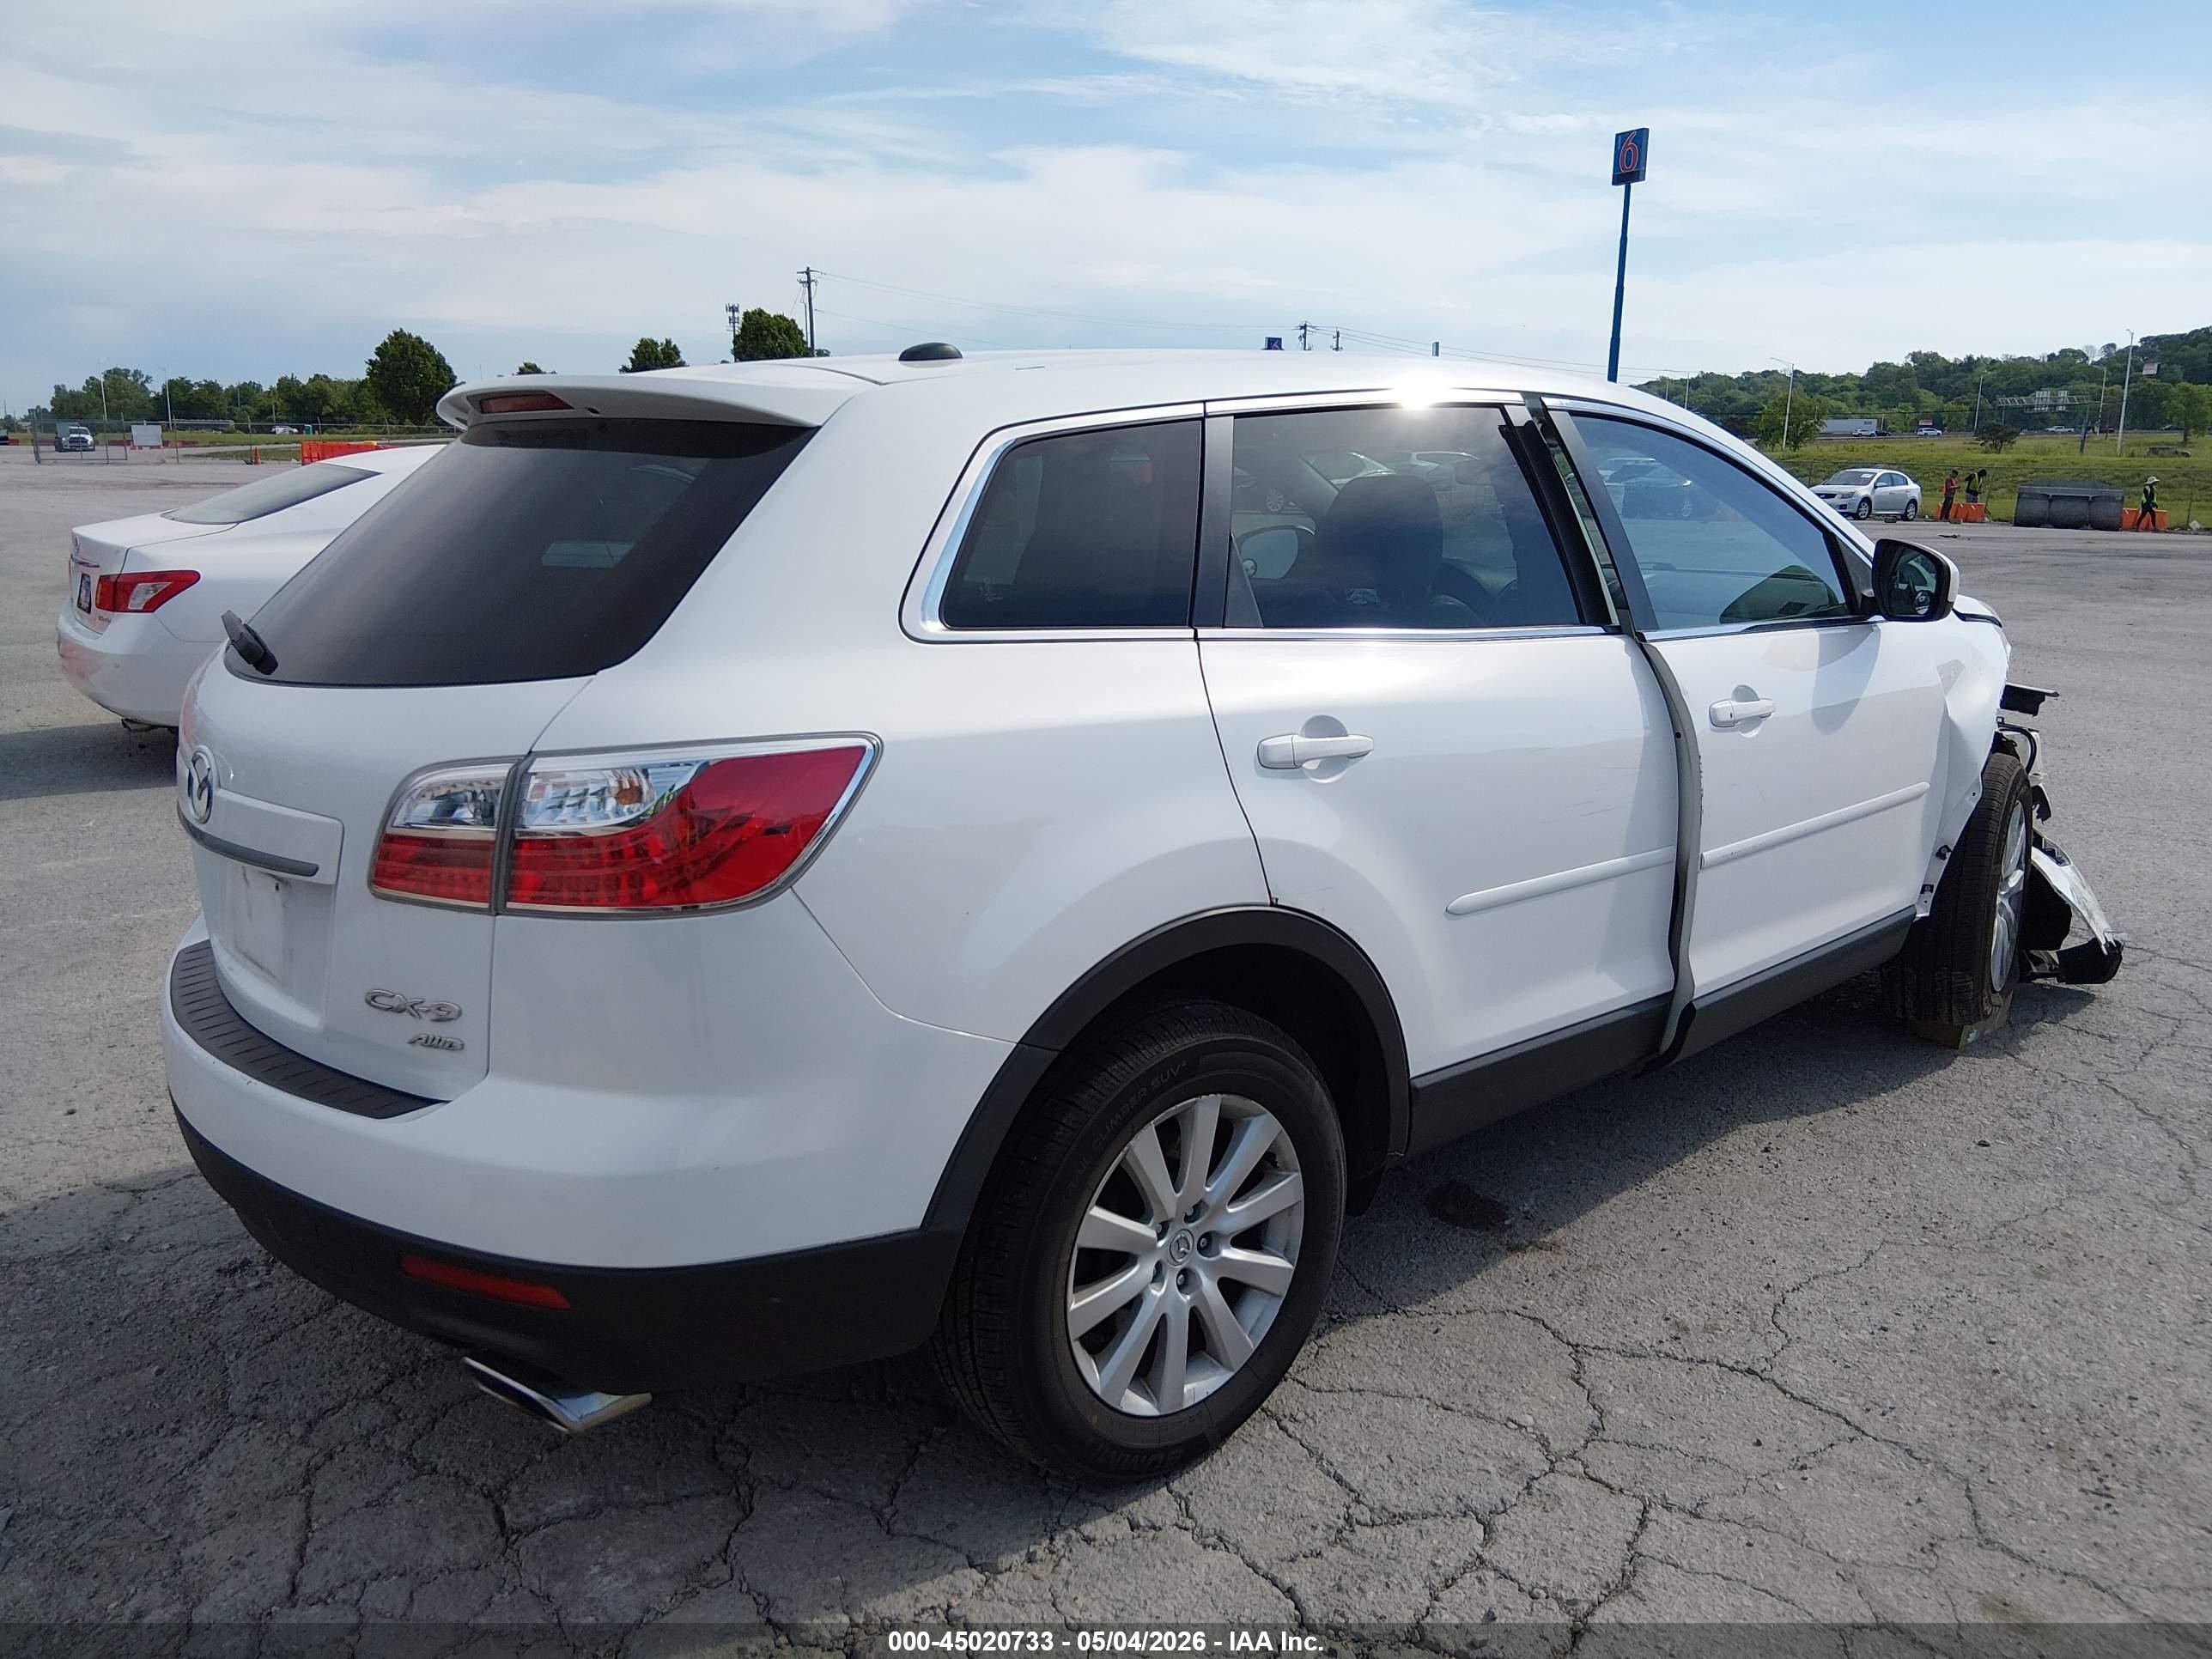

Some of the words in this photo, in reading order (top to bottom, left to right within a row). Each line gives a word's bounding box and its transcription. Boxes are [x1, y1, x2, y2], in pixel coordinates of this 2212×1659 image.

[1619, 131, 1638, 173] 6
[365, 989, 463, 1023] CX-9
[407, 1033, 465, 1051] AWD
[1150, 1062, 1181, 1090] SUV
